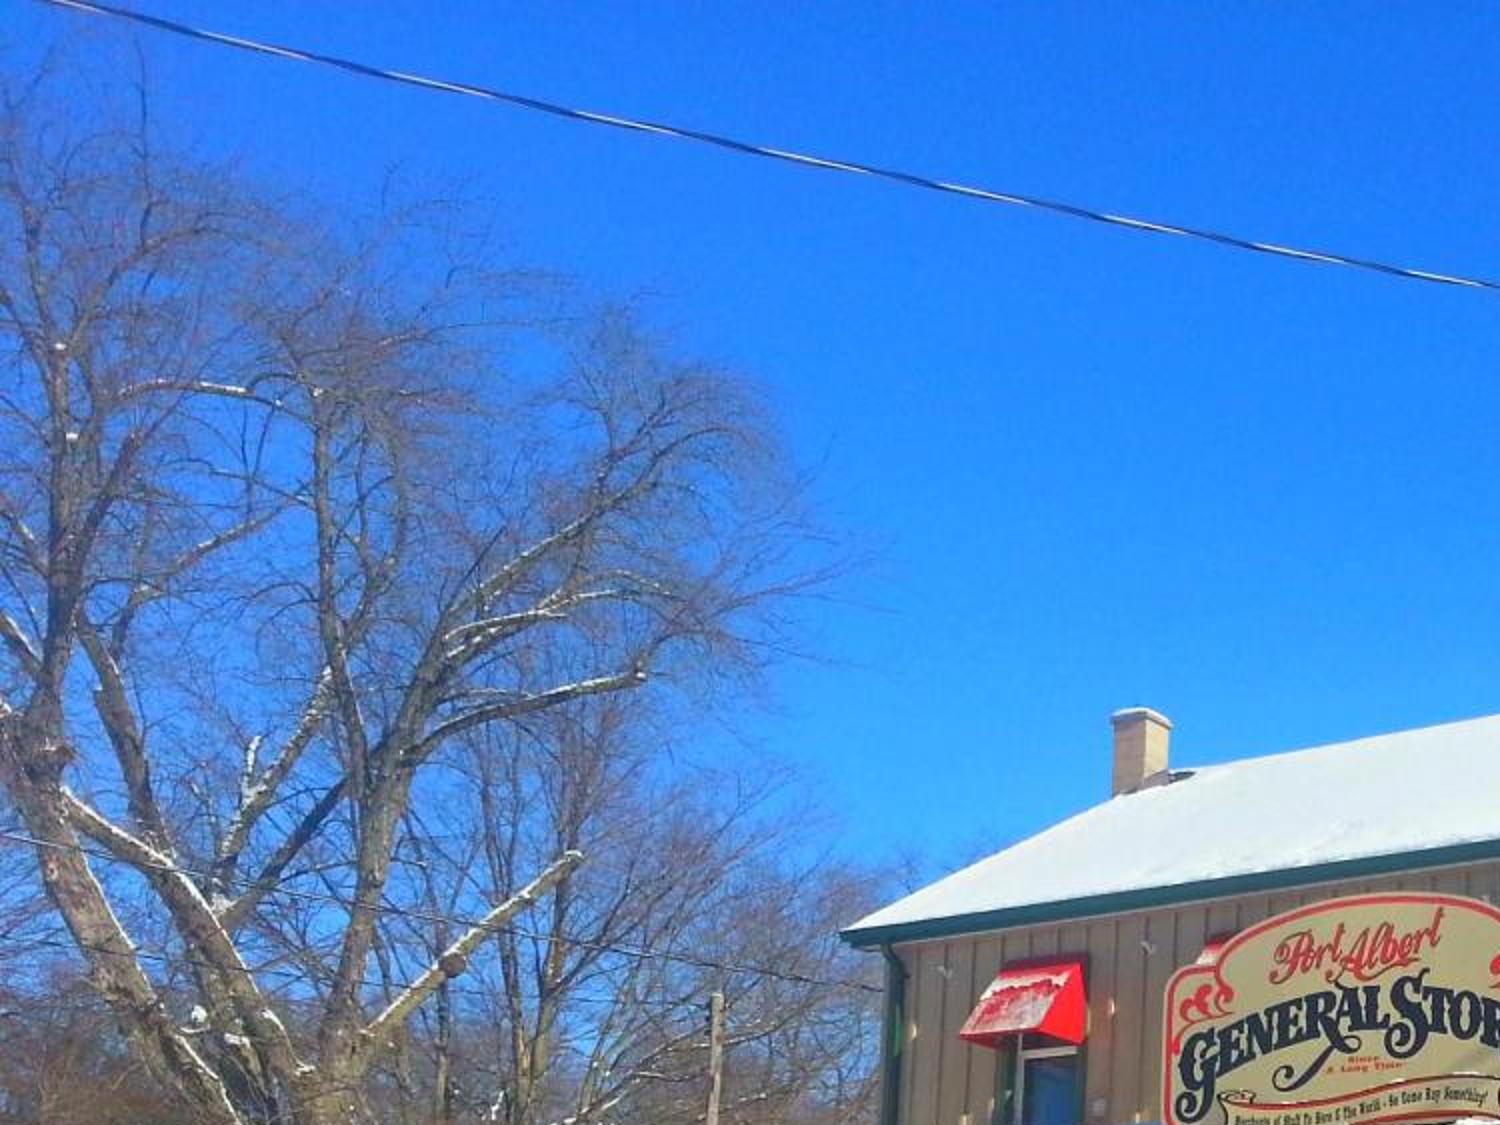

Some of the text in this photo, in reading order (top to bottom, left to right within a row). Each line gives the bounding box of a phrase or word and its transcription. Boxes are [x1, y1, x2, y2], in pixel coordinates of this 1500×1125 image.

[1269, 907, 1446, 984] Port Albert
[1175, 980, 1391, 1123] GENERAL
[1401, 1090, 1423, 1104] Come
[1424, 1087, 1441, 1103] Buy
